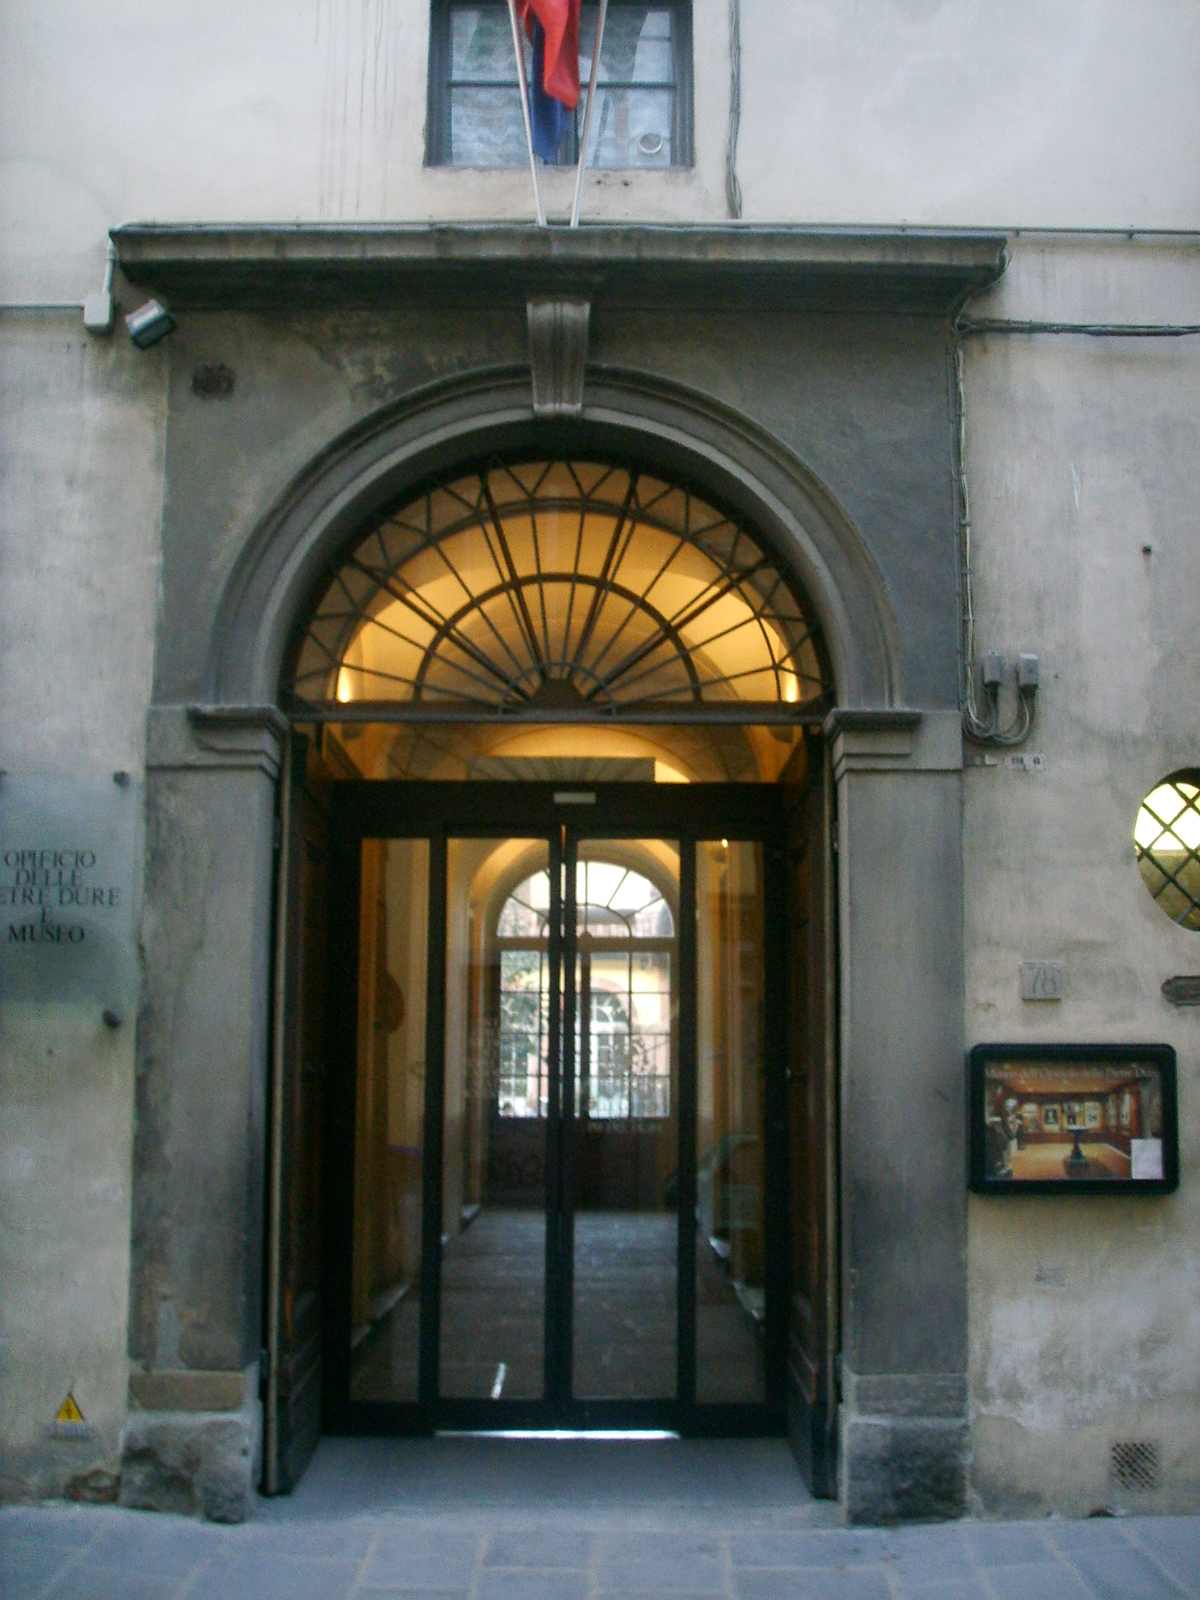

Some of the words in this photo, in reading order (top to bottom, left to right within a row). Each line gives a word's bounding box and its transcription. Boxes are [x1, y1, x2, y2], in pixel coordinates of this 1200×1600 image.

[16, 868, 81, 887] DELLE
[59, 887, 120, 905] DURE
[8, 923, 85, 942] MUSEO
